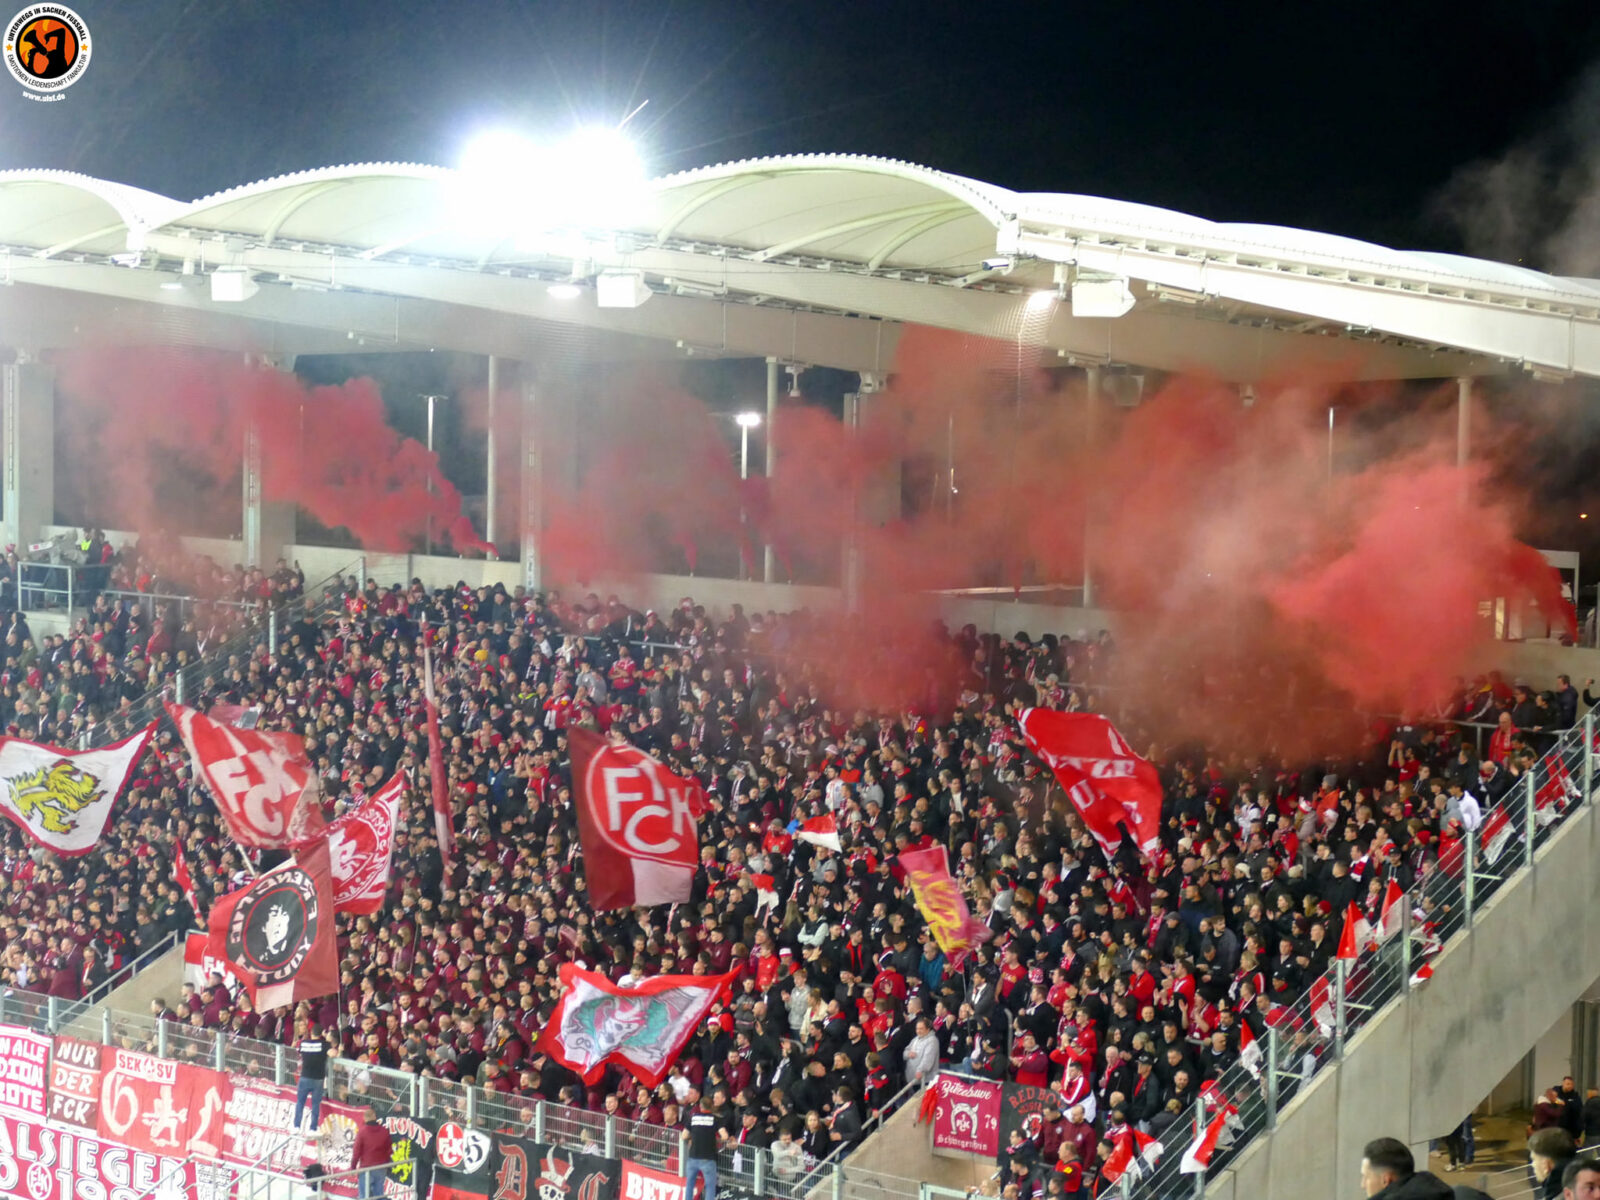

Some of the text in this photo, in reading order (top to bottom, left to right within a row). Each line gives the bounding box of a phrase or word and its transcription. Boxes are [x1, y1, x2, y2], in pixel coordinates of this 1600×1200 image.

[603, 767, 698, 854] FCK
[12, 1039, 46, 1064] ALLE
[57, 1041, 97, 1068] NUR
[118, 1054, 173, 1079] SEK SV
[54, 1067, 94, 1095] DER
[52, 1094, 91, 1125] FCK
[1008, 1087, 1035, 1109] RED
[438, 1137, 464, 1165] FCK
